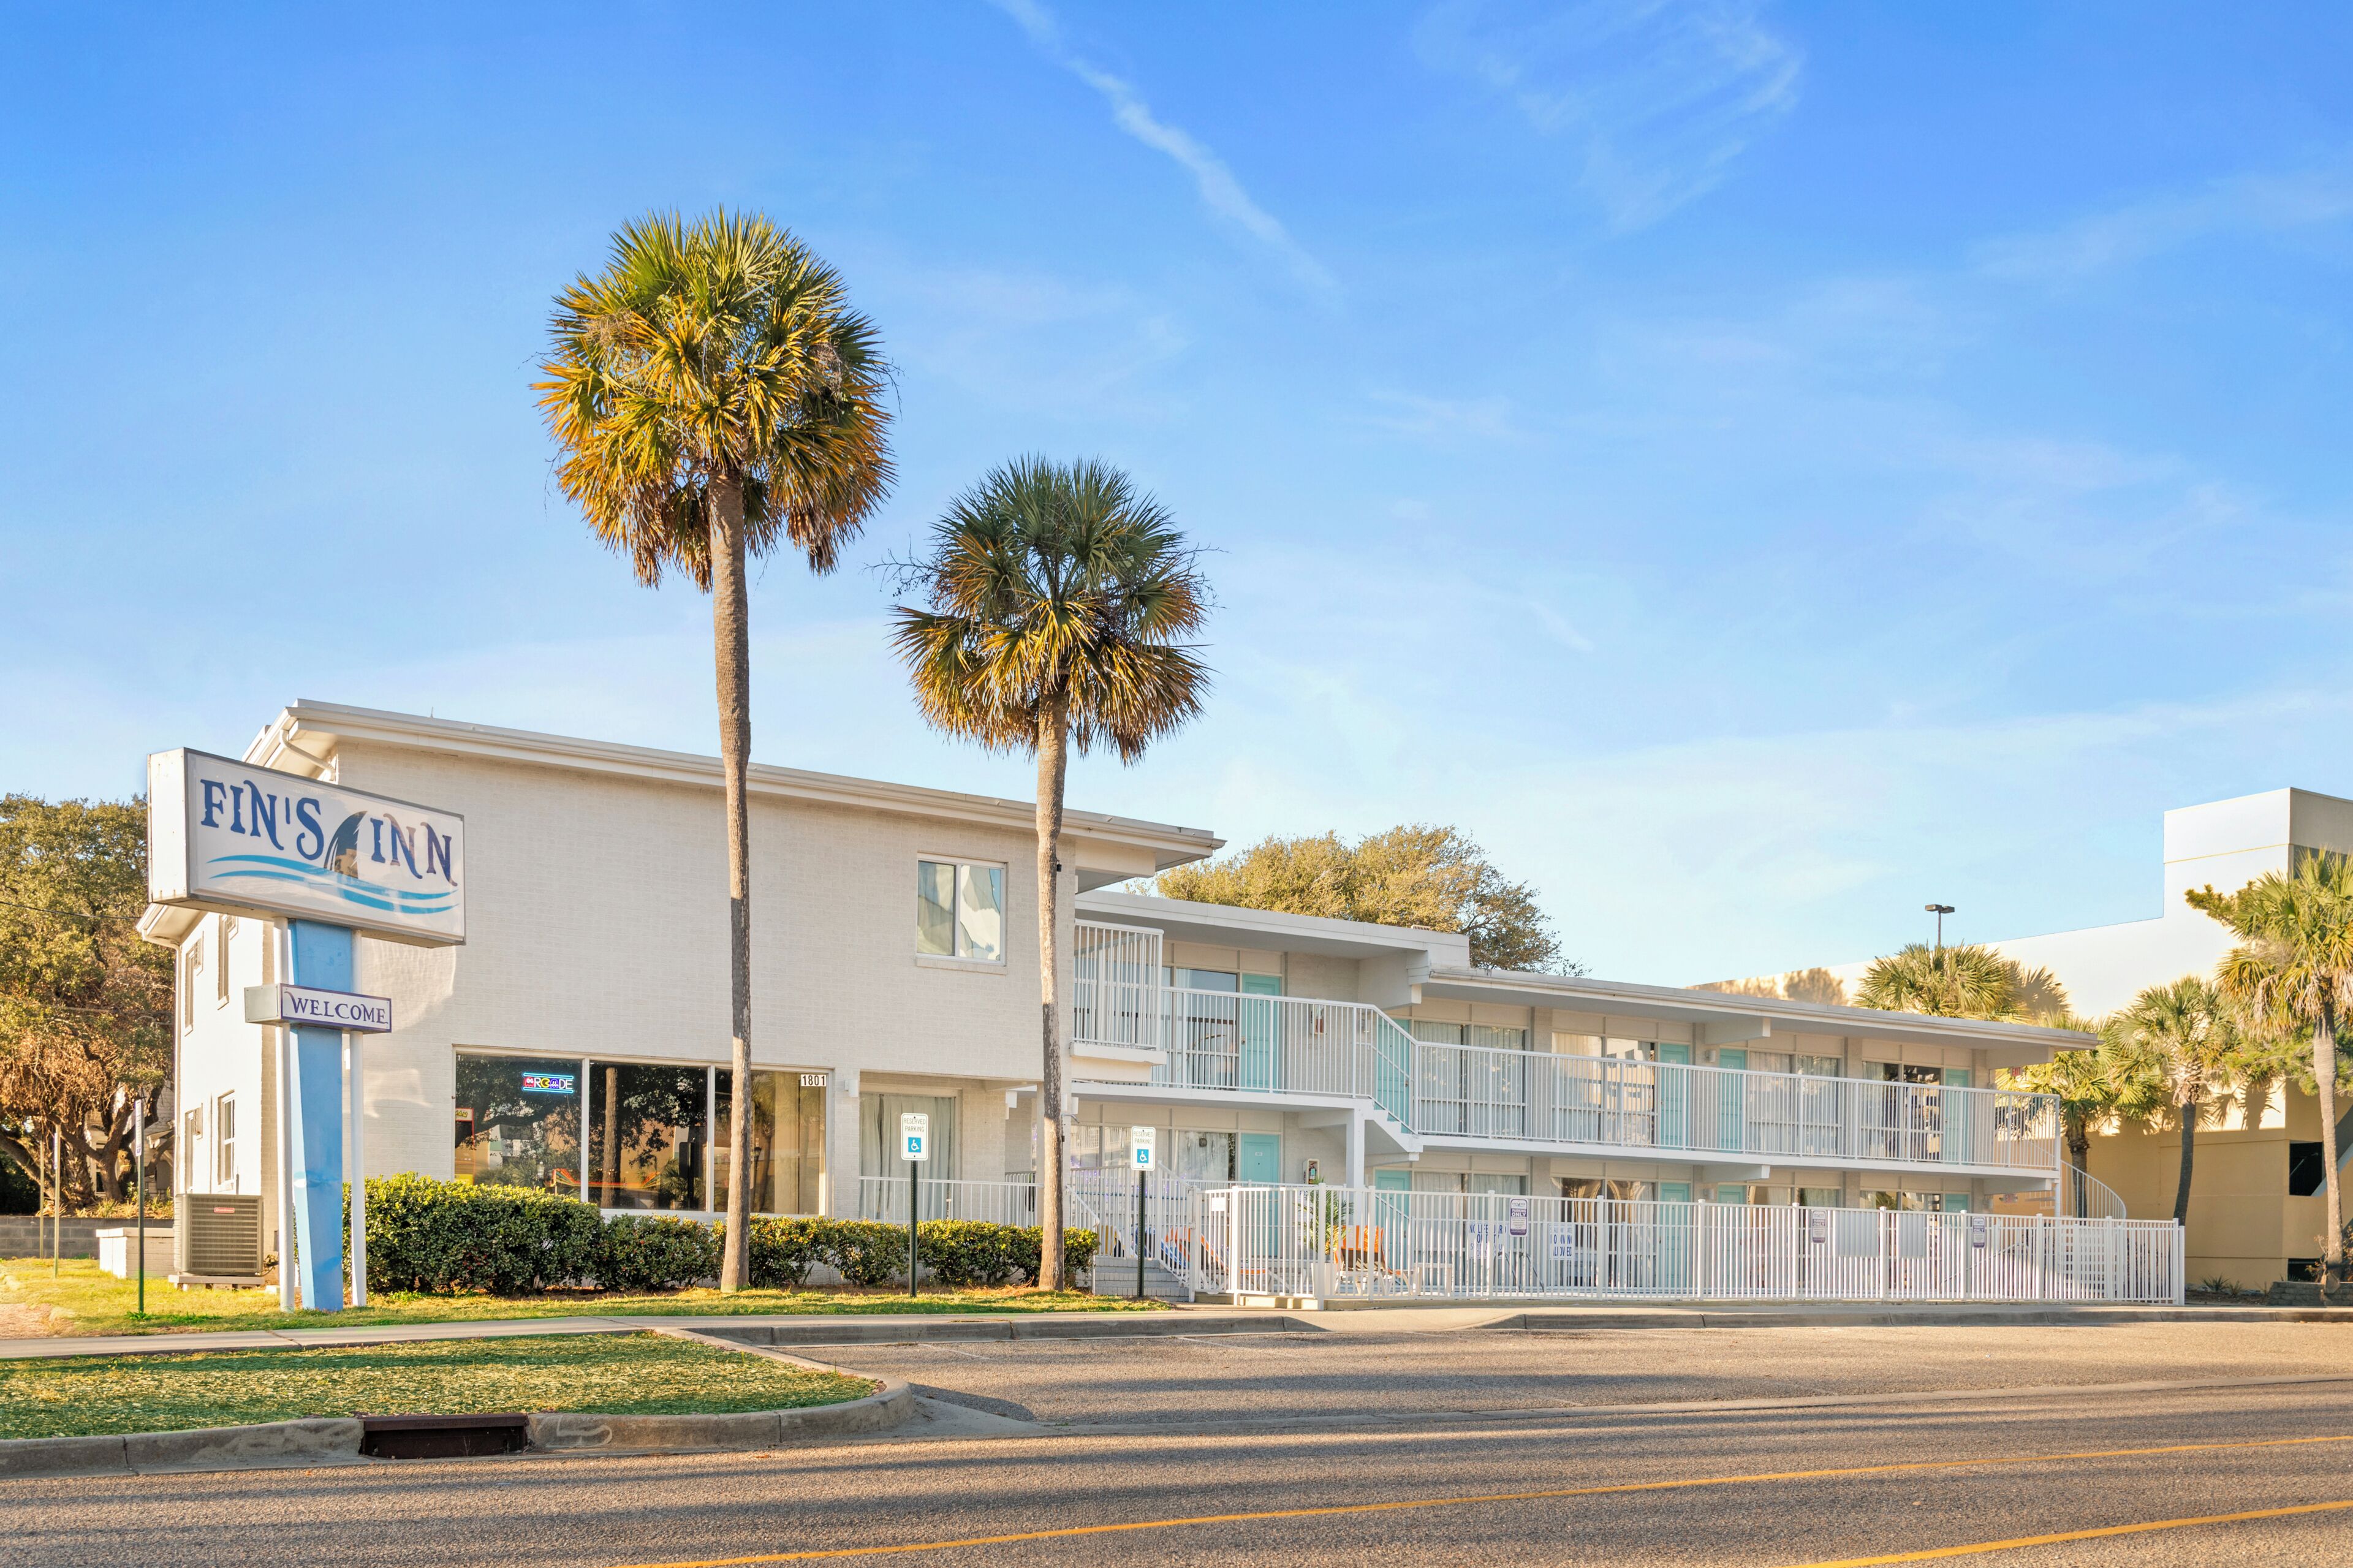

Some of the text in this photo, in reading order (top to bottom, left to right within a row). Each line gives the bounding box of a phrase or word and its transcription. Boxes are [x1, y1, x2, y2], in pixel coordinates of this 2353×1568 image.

[200, 779, 458, 887] FIN'S INN
[284, 991, 388, 1025] WELCOME
[802, 1075, 825, 1086] 1801
